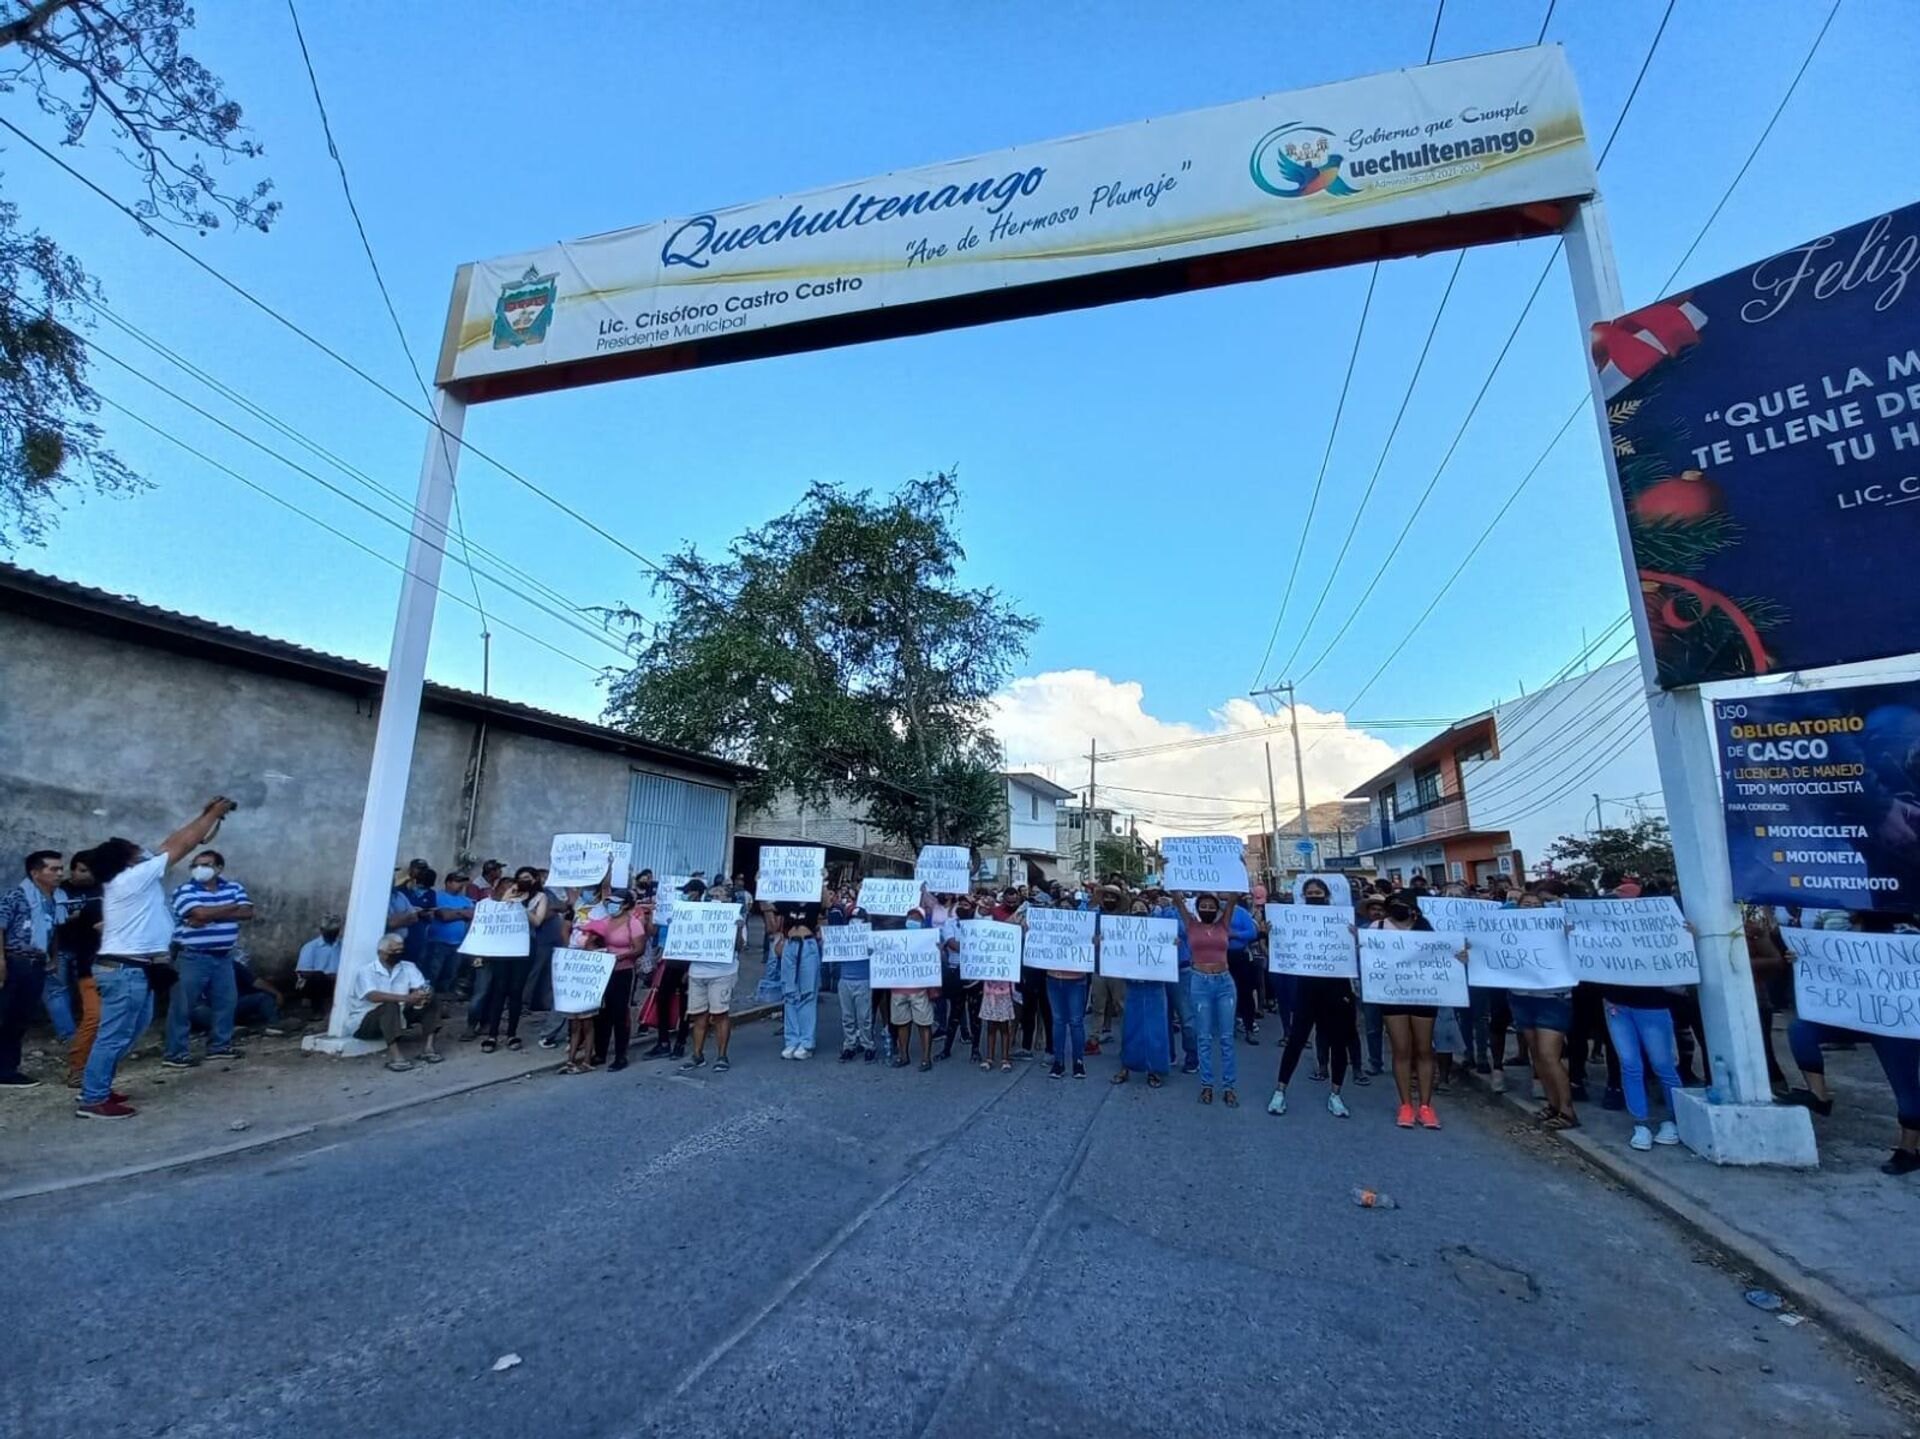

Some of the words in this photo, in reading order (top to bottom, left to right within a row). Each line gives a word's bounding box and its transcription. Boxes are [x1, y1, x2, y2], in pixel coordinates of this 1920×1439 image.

[1343, 126, 1420, 153] Gobierno
[1424, 118, 1453, 137] que
[1459, 101, 1528, 124] Cumple
[661, 166, 1047, 268] Quechultenango
[957, 226, 979, 249] de
[990, 212, 1079, 242] Hermoso
[1740, 214, 1920, 324] Feliz
[598, 318, 628, 335] Lic.
[635, 303, 718, 330] Crisóforo
[724, 289, 789, 313] Castro
[795, 276, 863, 300] Castro
[596, 328, 669, 351] Presidente
[673, 314, 747, 339] Municipal
[1821, 367, 1874, 399] LA
[1692, 440, 1734, 469] TE
[1746, 402, 1864, 455] LLENE
[1826, 433, 1876, 466] TU
[1837, 484, 1893, 509] LIC.
[1717, 705, 1747, 719] USO
[1730, 717, 1864, 739] OBLIGATORIO
[1727, 746, 1744, 757] DE
[1747, 739, 1828, 761] CASCO
[1734, 767, 1790, 780] LICENCIA
[1793, 766, 1810, 777] DE
[1813, 764, 1864, 777] MANEJO
[1736, 783, 1766, 795] TIPO
[1769, 781, 1864, 795] MOTOCICLISTA
[1728, 803, 1746, 811] PARA
[1767, 825, 1868, 838] MOTOCICLETA
[1177, 855, 1193, 866] EN
[1198, 855, 1213, 865] MI
[1786, 851, 1865, 864] MOTONETA
[1173, 868, 1220, 882] PUEBLO
[760, 880, 813, 894] GOBIERNO
[1803, 876, 1899, 891] CUATRIMOTO
[1421, 900, 1440, 915] DE
[1564, 900, 1578, 915] EL
[1591, 898, 1670, 916] EJERCITO
[1067, 911, 1087, 922] HAY
[1116, 918, 1131, 930] NO
[1302, 914, 1316, 923] mi
[1323, 912, 1349, 928] pueblo
[1603, 915, 1681, 933] INTERROGA
[1292, 929, 1308, 939] paz
[1573, 934, 1622, 949] TENGO
[1631, 933, 1678, 948] MIEDO
[900, 936, 908, 951] Y
[1305, 941, 1313, 951] el
[1367, 937, 1385, 950] No
[1392, 936, 1404, 950] al
[1788, 935, 1819, 959] DE
[1070, 946, 1093, 963] PAZ
[1103, 946, 1110, 956] A
[1115, 945, 1127, 957] LA
[1137, 943, 1164, 966] PAZ
[1484, 948, 1556, 970] LIBRE
[1576, 954, 1594, 968] YO
[1600, 956, 1647, 971] VIVIA
[1652, 954, 1673, 971] EN
[1674, 950, 1698, 969] PAZ
[1373, 958, 1388, 969] de
[1395, 960, 1411, 969] mi
[1419, 957, 1452, 972] pueblo
[1368, 972, 1386, 983] por
[1394, 972, 1425, 983] parte
[1432, 970, 1449, 982] del
[1800, 960, 1813, 981] A
[1817, 963, 1872, 989] CASA
[1383, 985, 1437, 997] Gobierno
[1805, 985, 1852, 1009] SER
[1856, 992, 1920, 1028] LIBR
